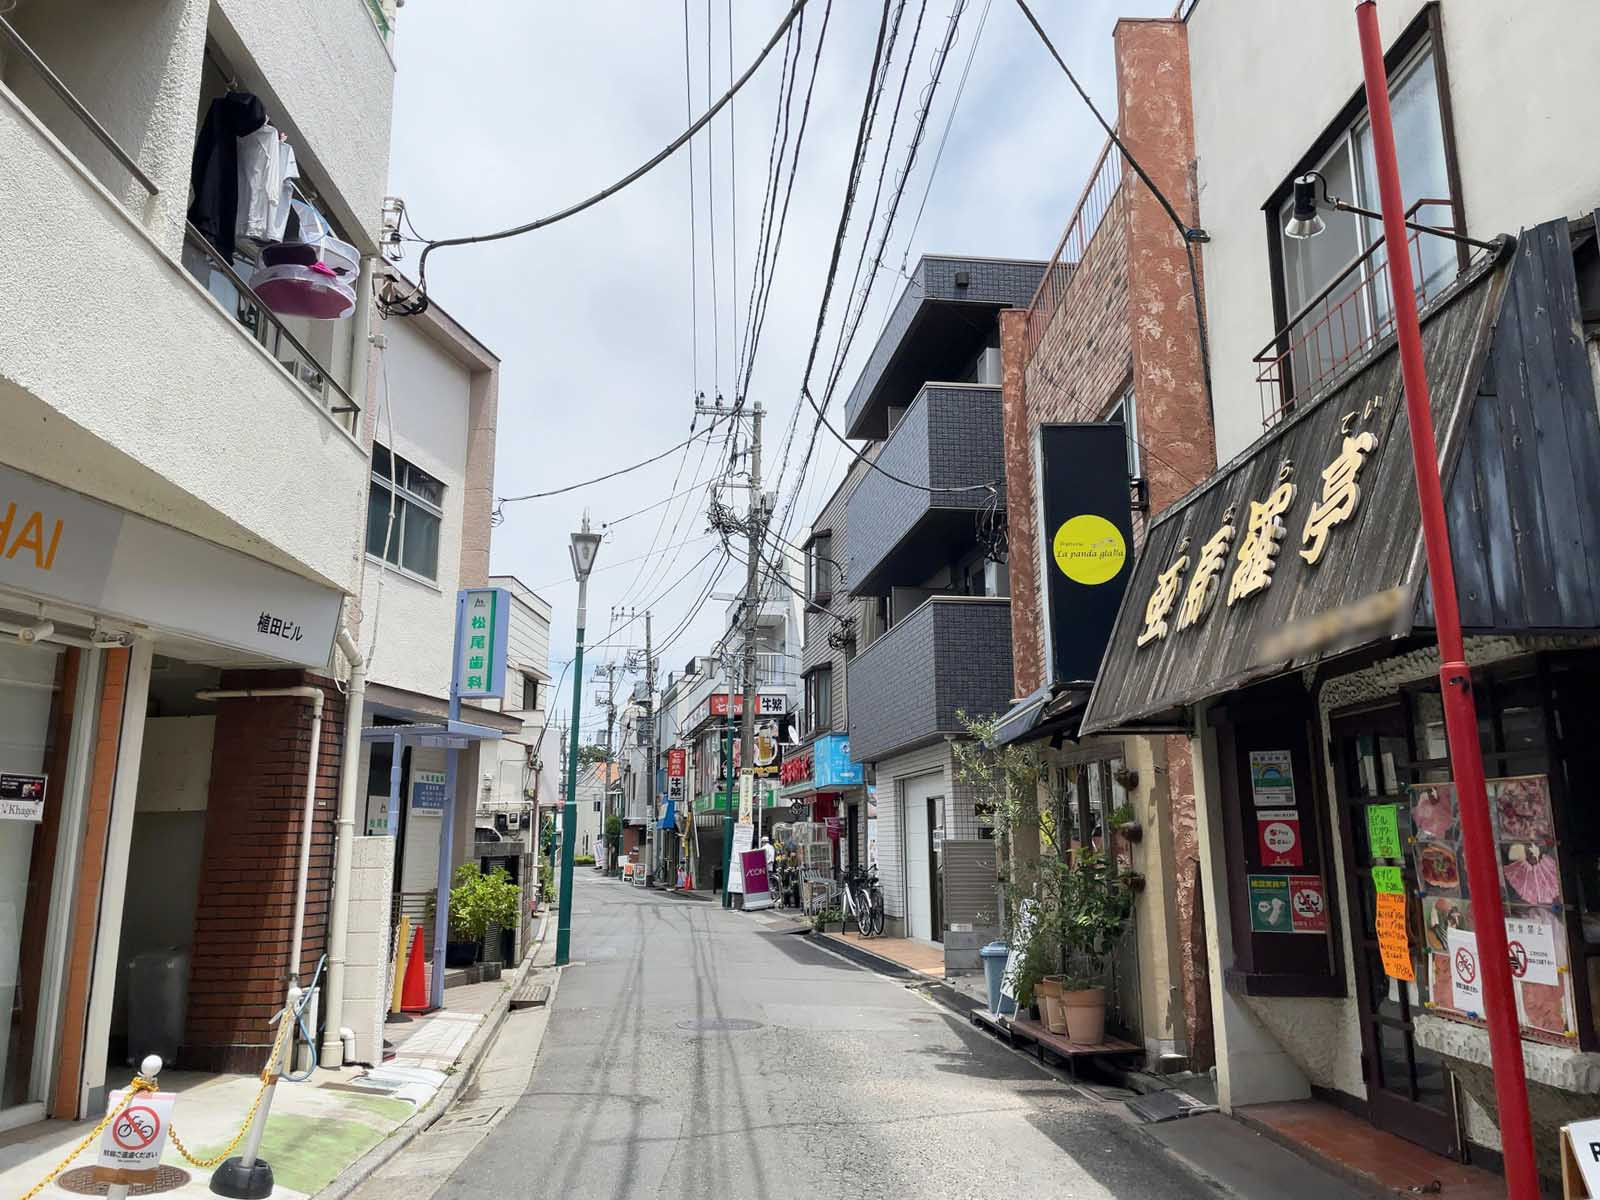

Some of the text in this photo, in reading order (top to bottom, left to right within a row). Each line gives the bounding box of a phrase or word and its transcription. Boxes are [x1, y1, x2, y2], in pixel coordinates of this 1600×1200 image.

[1070, 550, 1097, 560] panda
[257, 611, 303, 642] 植田ビル
[467, 615, 486, 689] 松尾歯科
